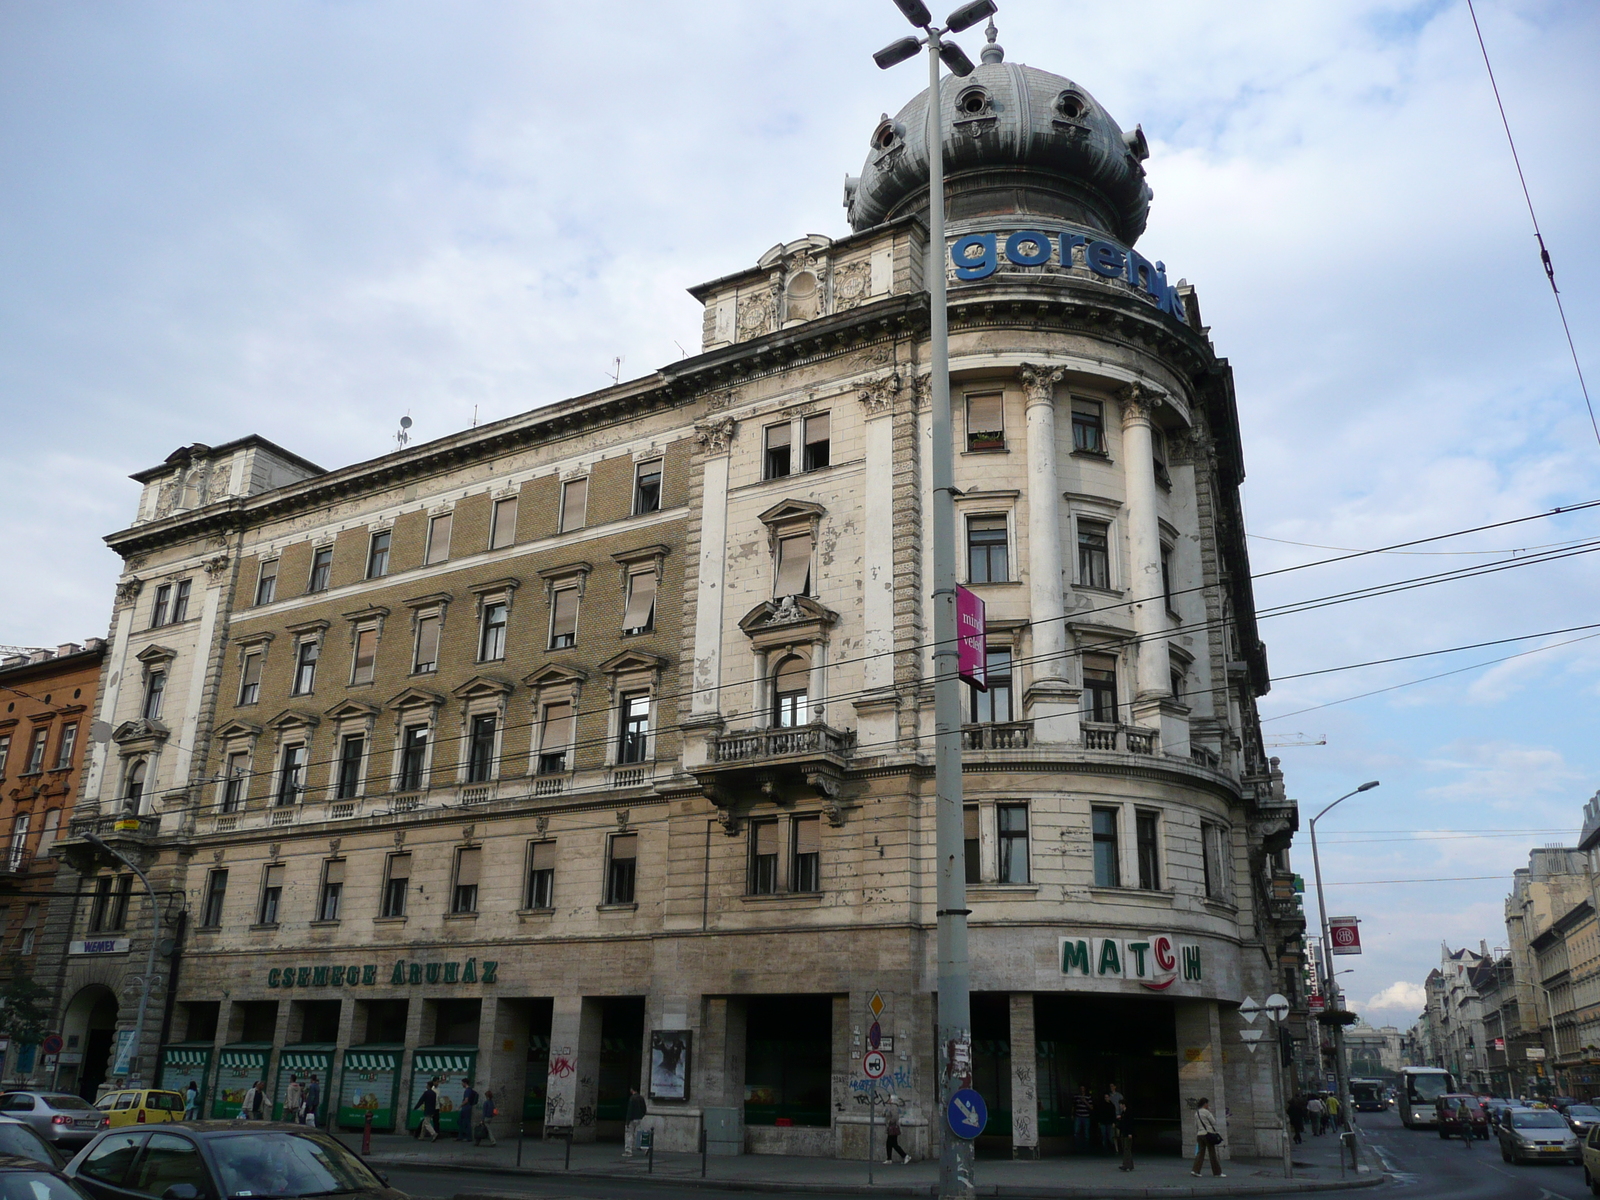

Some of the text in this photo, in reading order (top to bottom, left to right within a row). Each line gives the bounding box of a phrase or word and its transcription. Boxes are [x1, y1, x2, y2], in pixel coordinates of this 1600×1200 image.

[951, 230, 1185, 322] gorenje
[84, 940, 116, 953] WEMEX
[1061, 937, 1202, 981] MATCH
[267, 957, 498, 987] CSEMEGE ÁRUHÁZ
